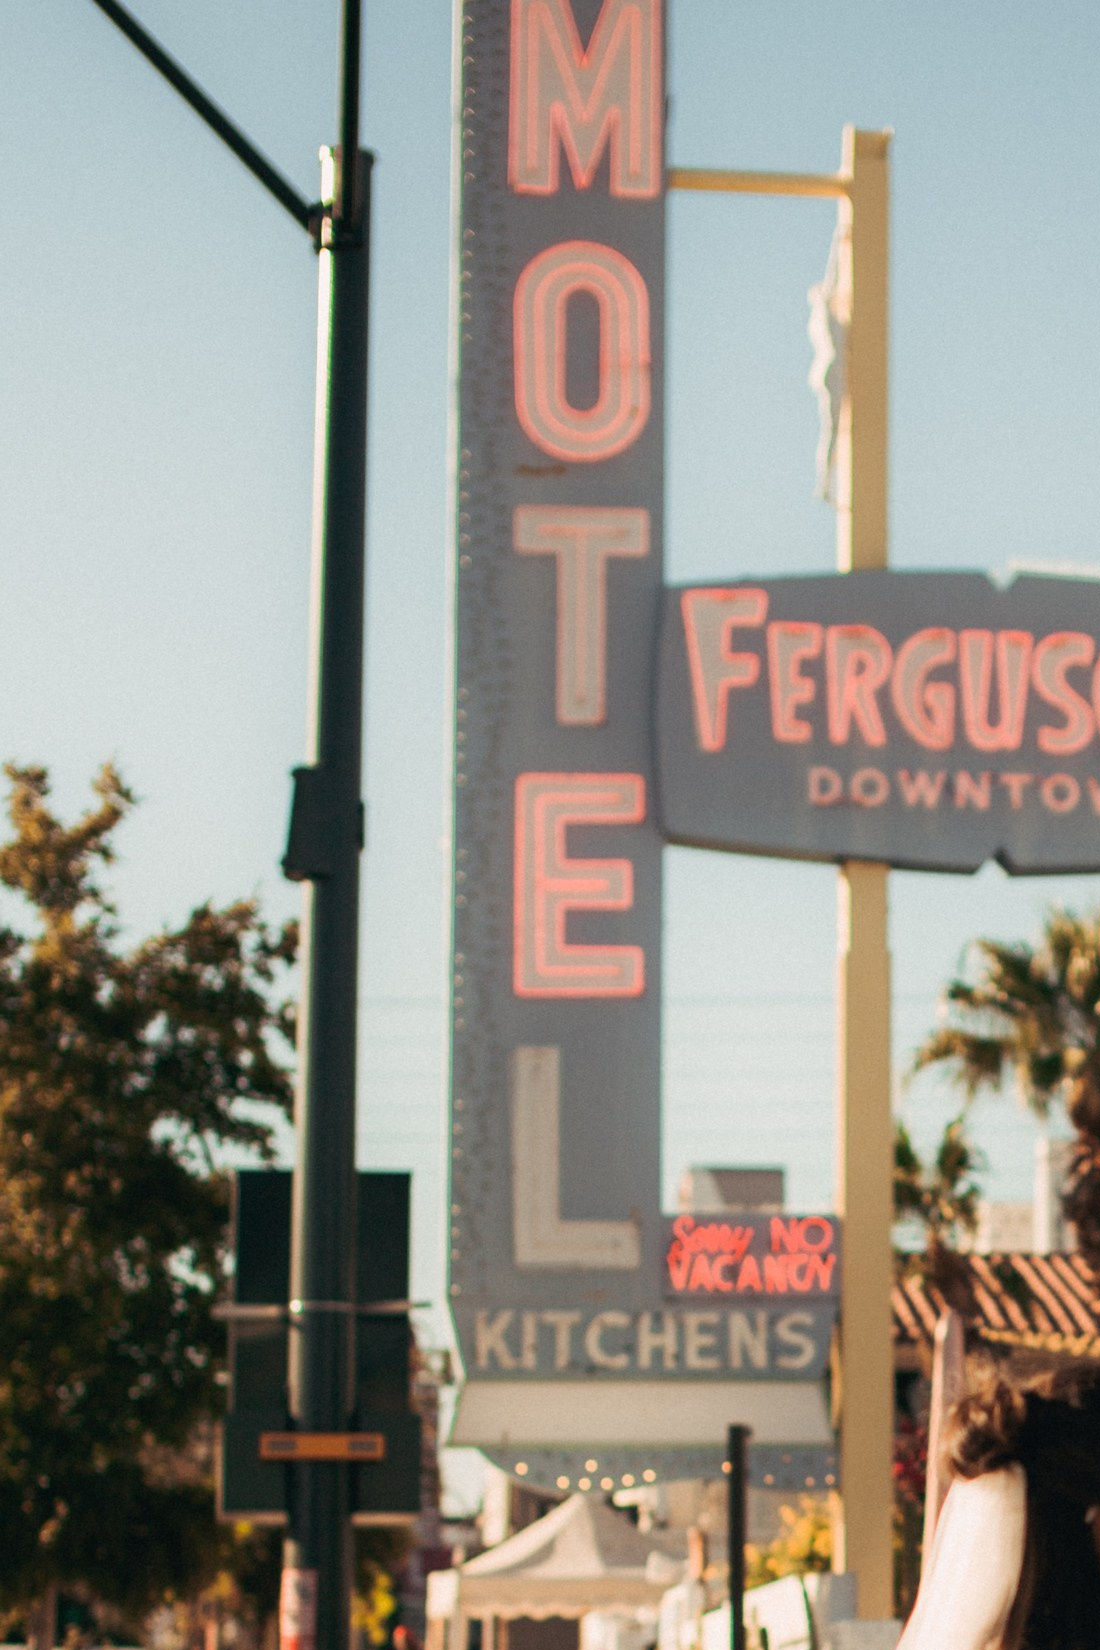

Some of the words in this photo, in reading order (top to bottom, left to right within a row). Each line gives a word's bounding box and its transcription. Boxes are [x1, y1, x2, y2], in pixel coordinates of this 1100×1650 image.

[507, 0, 662, 1269] MOTEL
[770, 1216, 834, 1253] NO
[667, 1249, 837, 1294] VACANCY
[474, 1310, 816, 1371] KITCHENS
